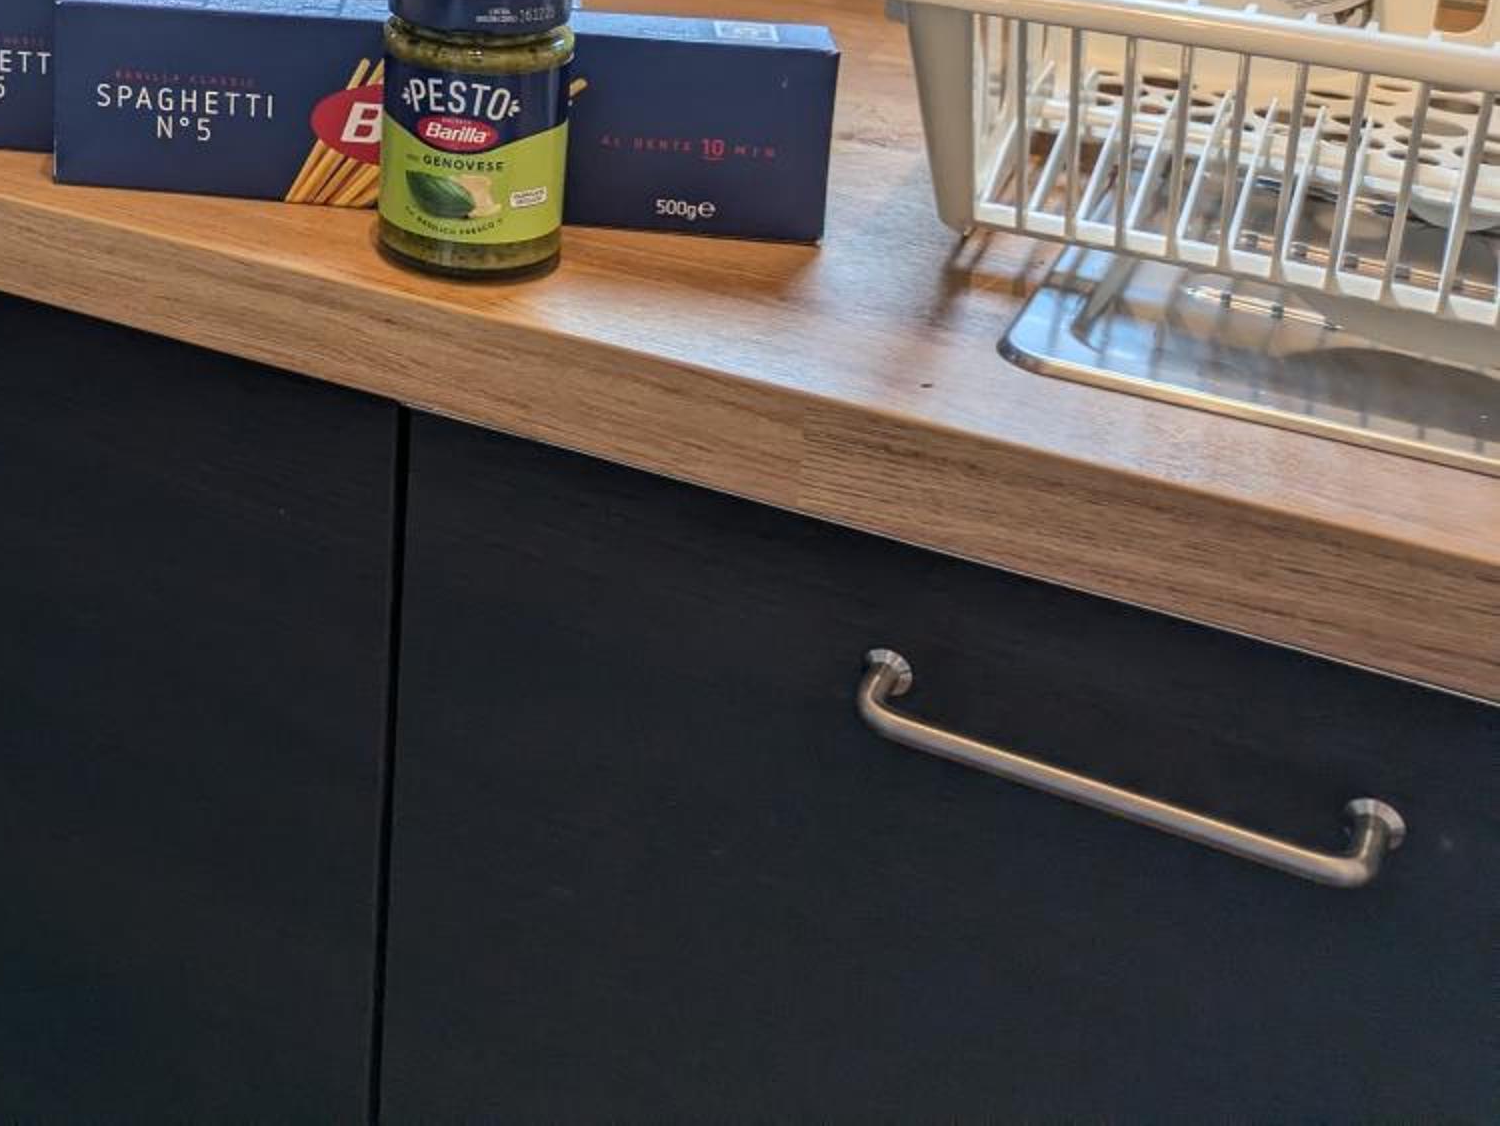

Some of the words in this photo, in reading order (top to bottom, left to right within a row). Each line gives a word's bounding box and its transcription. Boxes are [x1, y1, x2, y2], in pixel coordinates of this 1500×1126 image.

[96, 83, 274, 119] SPAGHETTI
[409, 78, 511, 122] PESTO
[425, 121, 487, 144] Barilla
[702, 138, 725, 156] 10
[422, 154, 506, 172] GENOVESE
